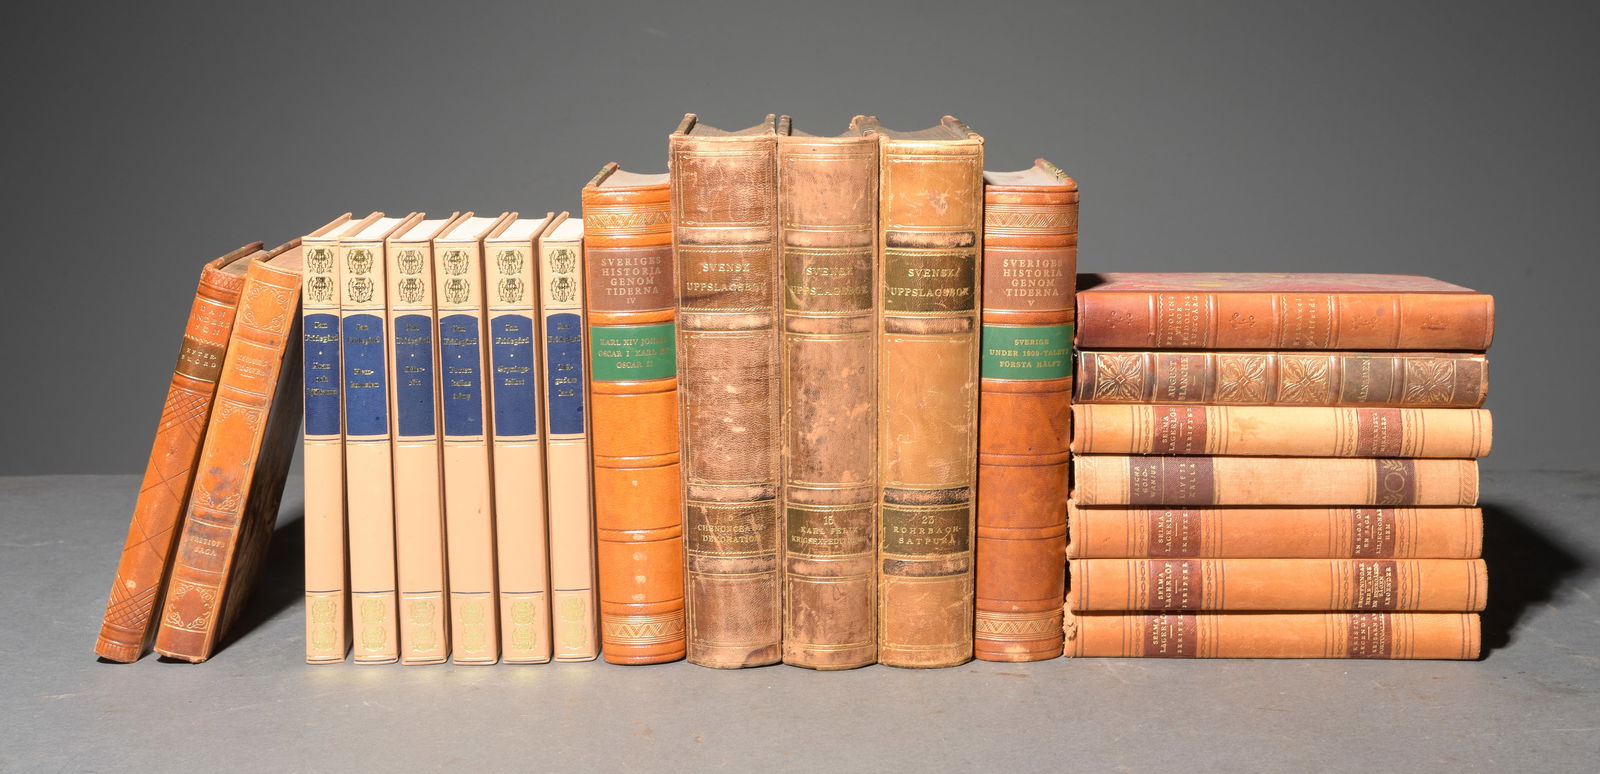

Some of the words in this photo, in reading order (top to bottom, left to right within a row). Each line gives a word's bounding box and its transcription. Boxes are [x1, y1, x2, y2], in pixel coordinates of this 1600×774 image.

[601, 257, 662, 266] SVERIGES
[1003, 259, 1063, 268] SVERIGES
[602, 268, 661, 276] HISTORIA
[702, 263, 751, 272] SVENSK
[908, 268, 955, 277] SVENSK
[1003, 269, 1063, 277] HISTORIA
[610, 277, 654, 286] GENOM
[1012, 279, 1055, 287] GENOM
[606, 287, 659, 296] TIDERNA
[890, 287, 969, 298] UPPSLAGSBOK
[1005, 288, 1059, 296] TIDERNA
[1191, 296, 1199, 345] LUSTGÅRD
[989, 349, 1018, 357] UNDER
[616, 361, 642, 369] OSCAR
[1000, 360, 1032, 368] FÖRSTA
[1168, 360, 1177, 397] AUGUST
[1178, 357, 1188, 400] BLANCHE
[824, 515, 834, 525] 15
[922, 516, 935, 524] 23
[898, 536, 955, 544] SATPURA
[1364, 538, 1369, 548] EN
[1164, 562, 1172, 608] LAGERLÖF
